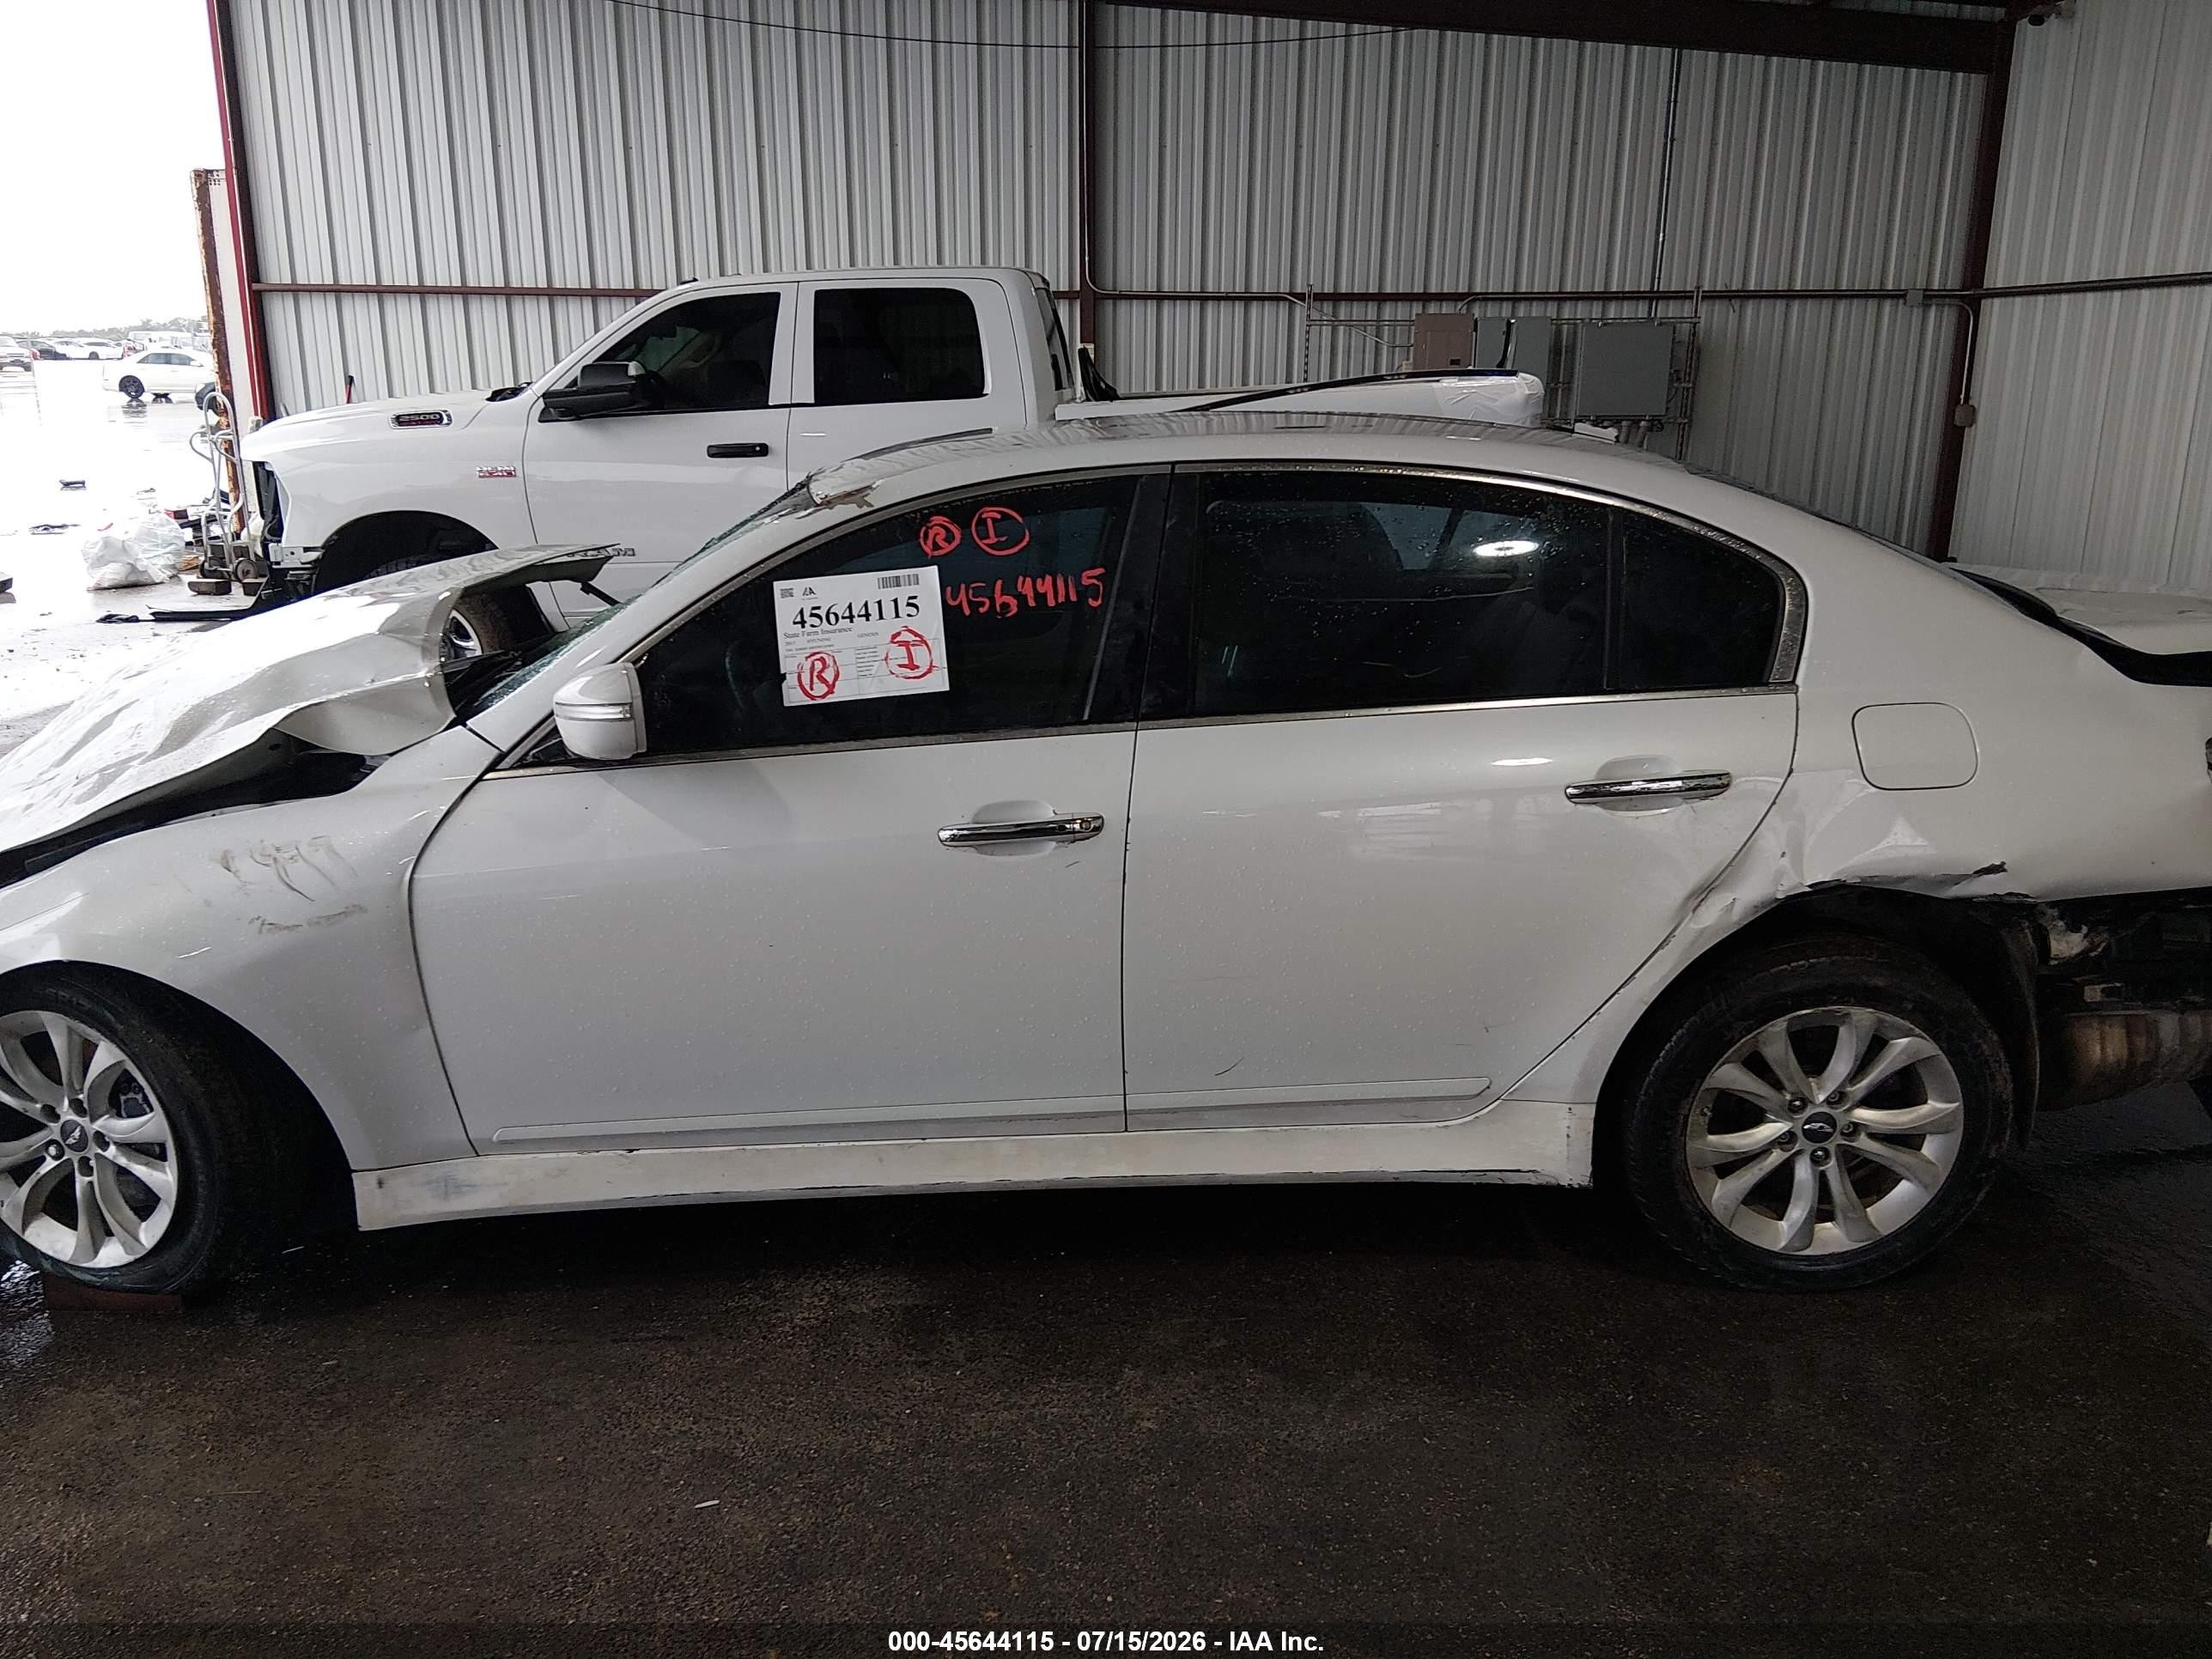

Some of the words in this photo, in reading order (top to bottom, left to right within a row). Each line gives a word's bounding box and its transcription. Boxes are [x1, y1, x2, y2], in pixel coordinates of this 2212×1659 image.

[945, 567, 1105, 618] 45644115
[792, 595, 921, 629] 45644115
[801, 629, 820, 637] Farm
[821, 627, 853, 635] Insurance
